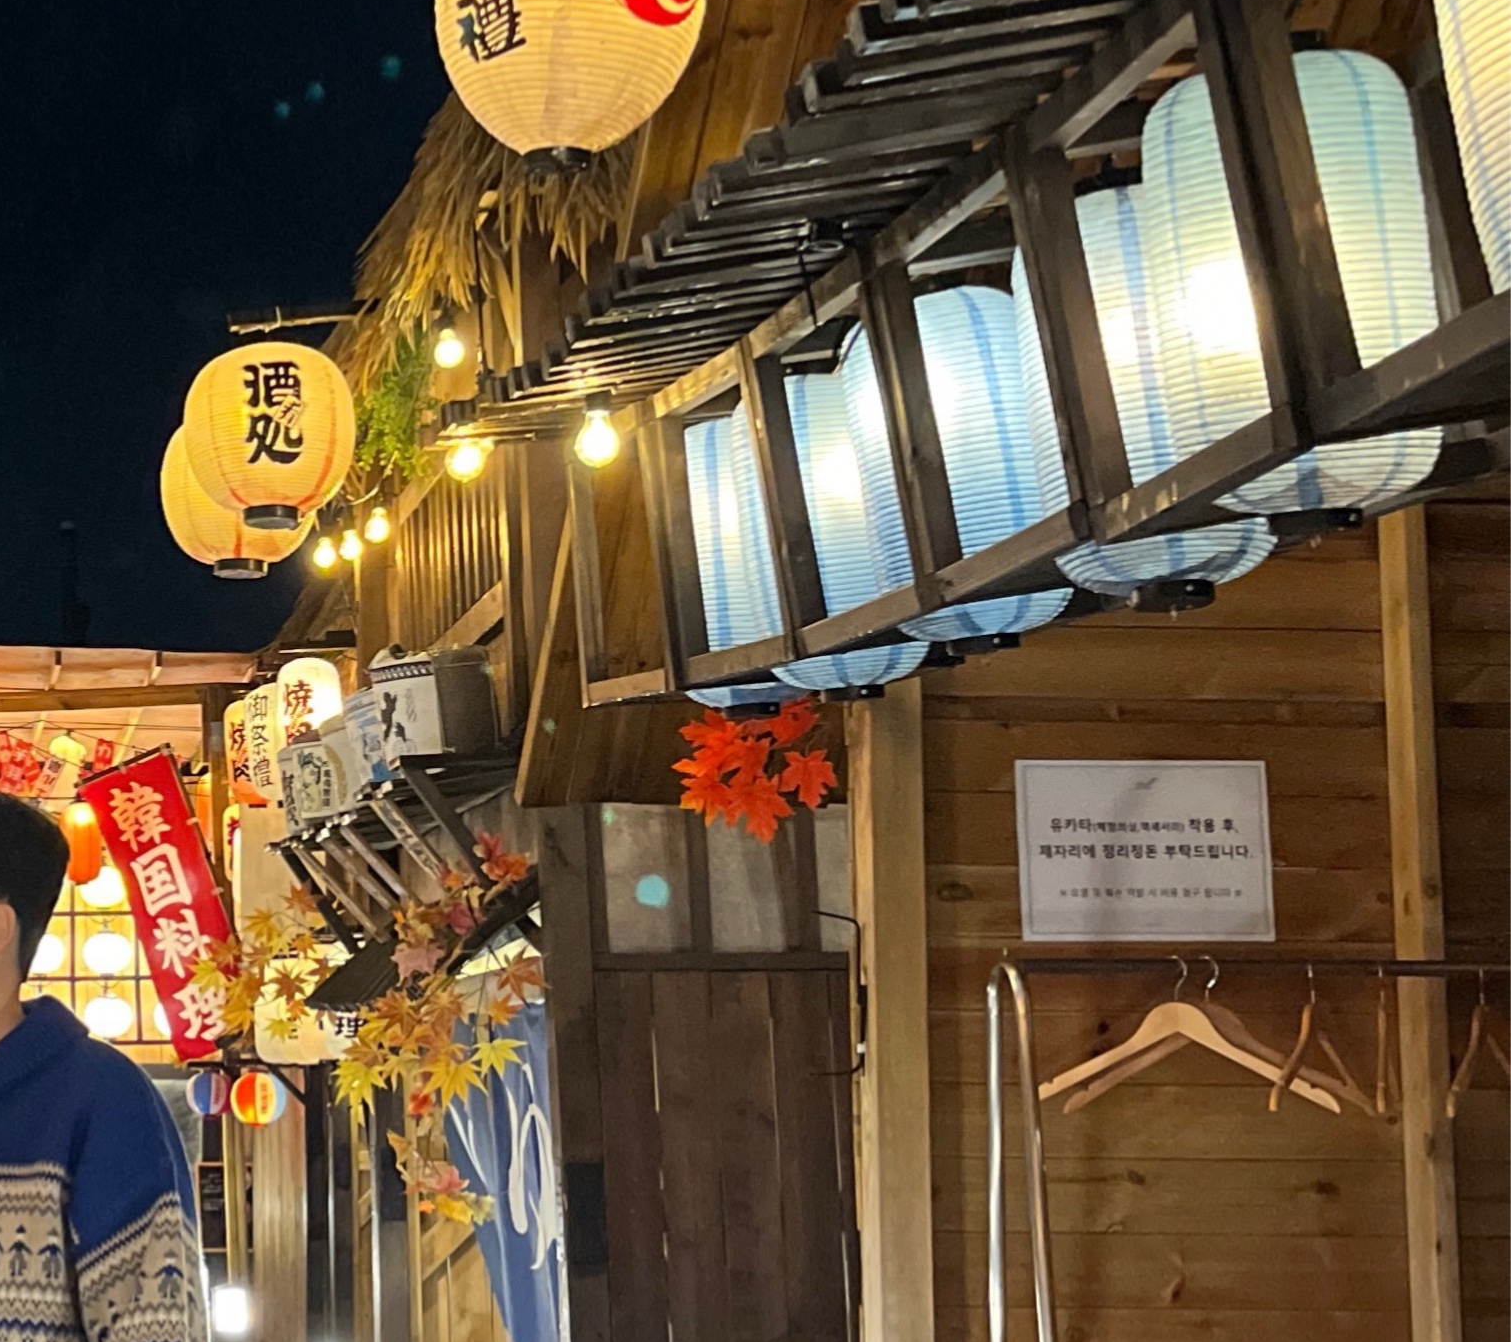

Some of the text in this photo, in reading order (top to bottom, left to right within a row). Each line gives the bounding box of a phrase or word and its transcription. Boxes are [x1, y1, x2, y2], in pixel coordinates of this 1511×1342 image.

[242, 360, 304, 466] 酒処
[1039, 844, 1095, 859] 제자리에
[1103, 844, 1157, 859] 정리정돈
[107, 781, 229, 1041] 韓国料理
